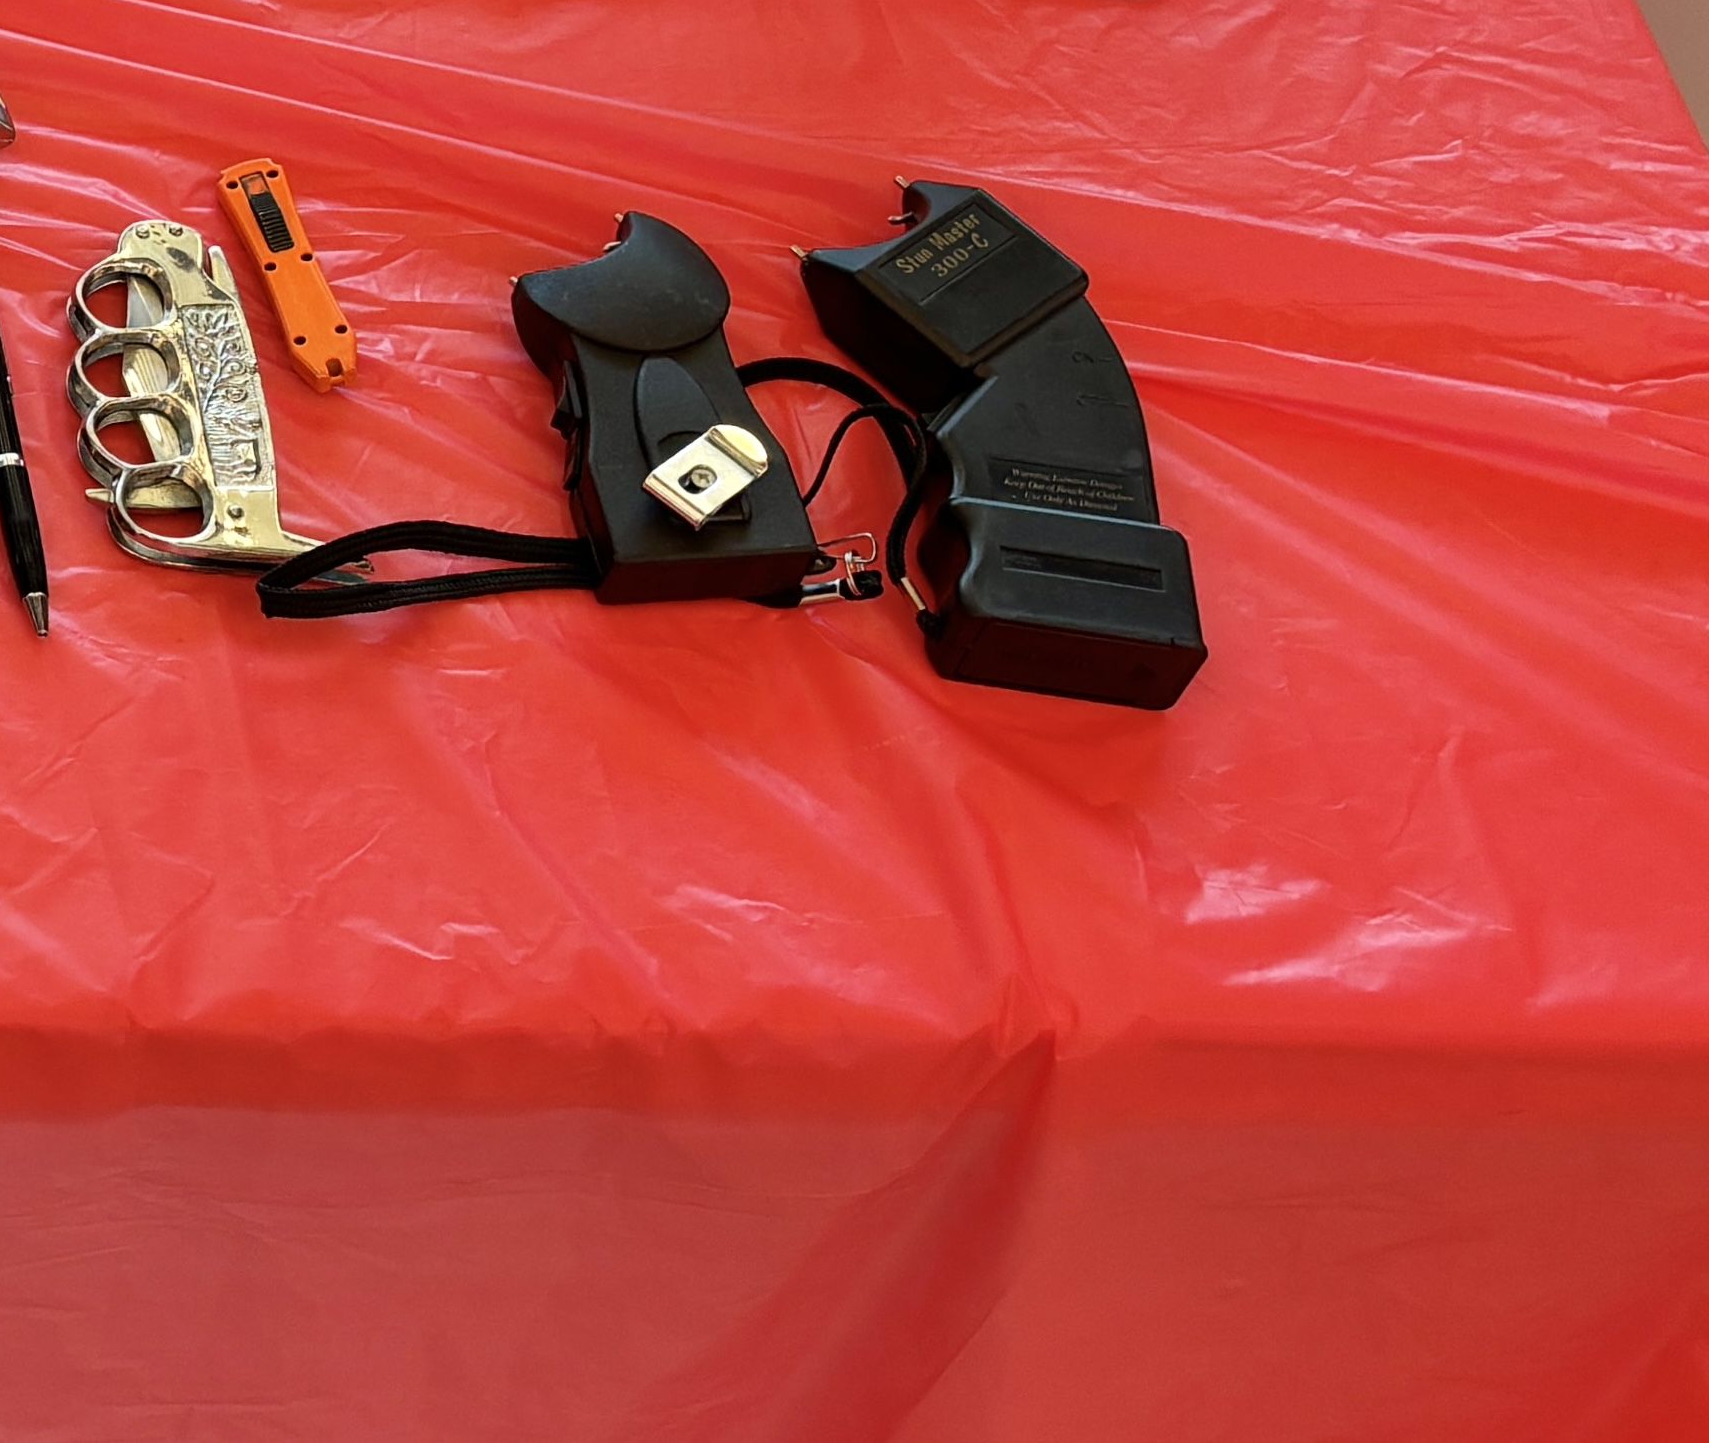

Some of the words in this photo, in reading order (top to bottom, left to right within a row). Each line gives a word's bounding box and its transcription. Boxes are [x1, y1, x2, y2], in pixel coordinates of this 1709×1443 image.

[895, 248, 934, 274] Stun
[928, 213, 981, 251] Master
[930, 232, 989, 277] 300-C
